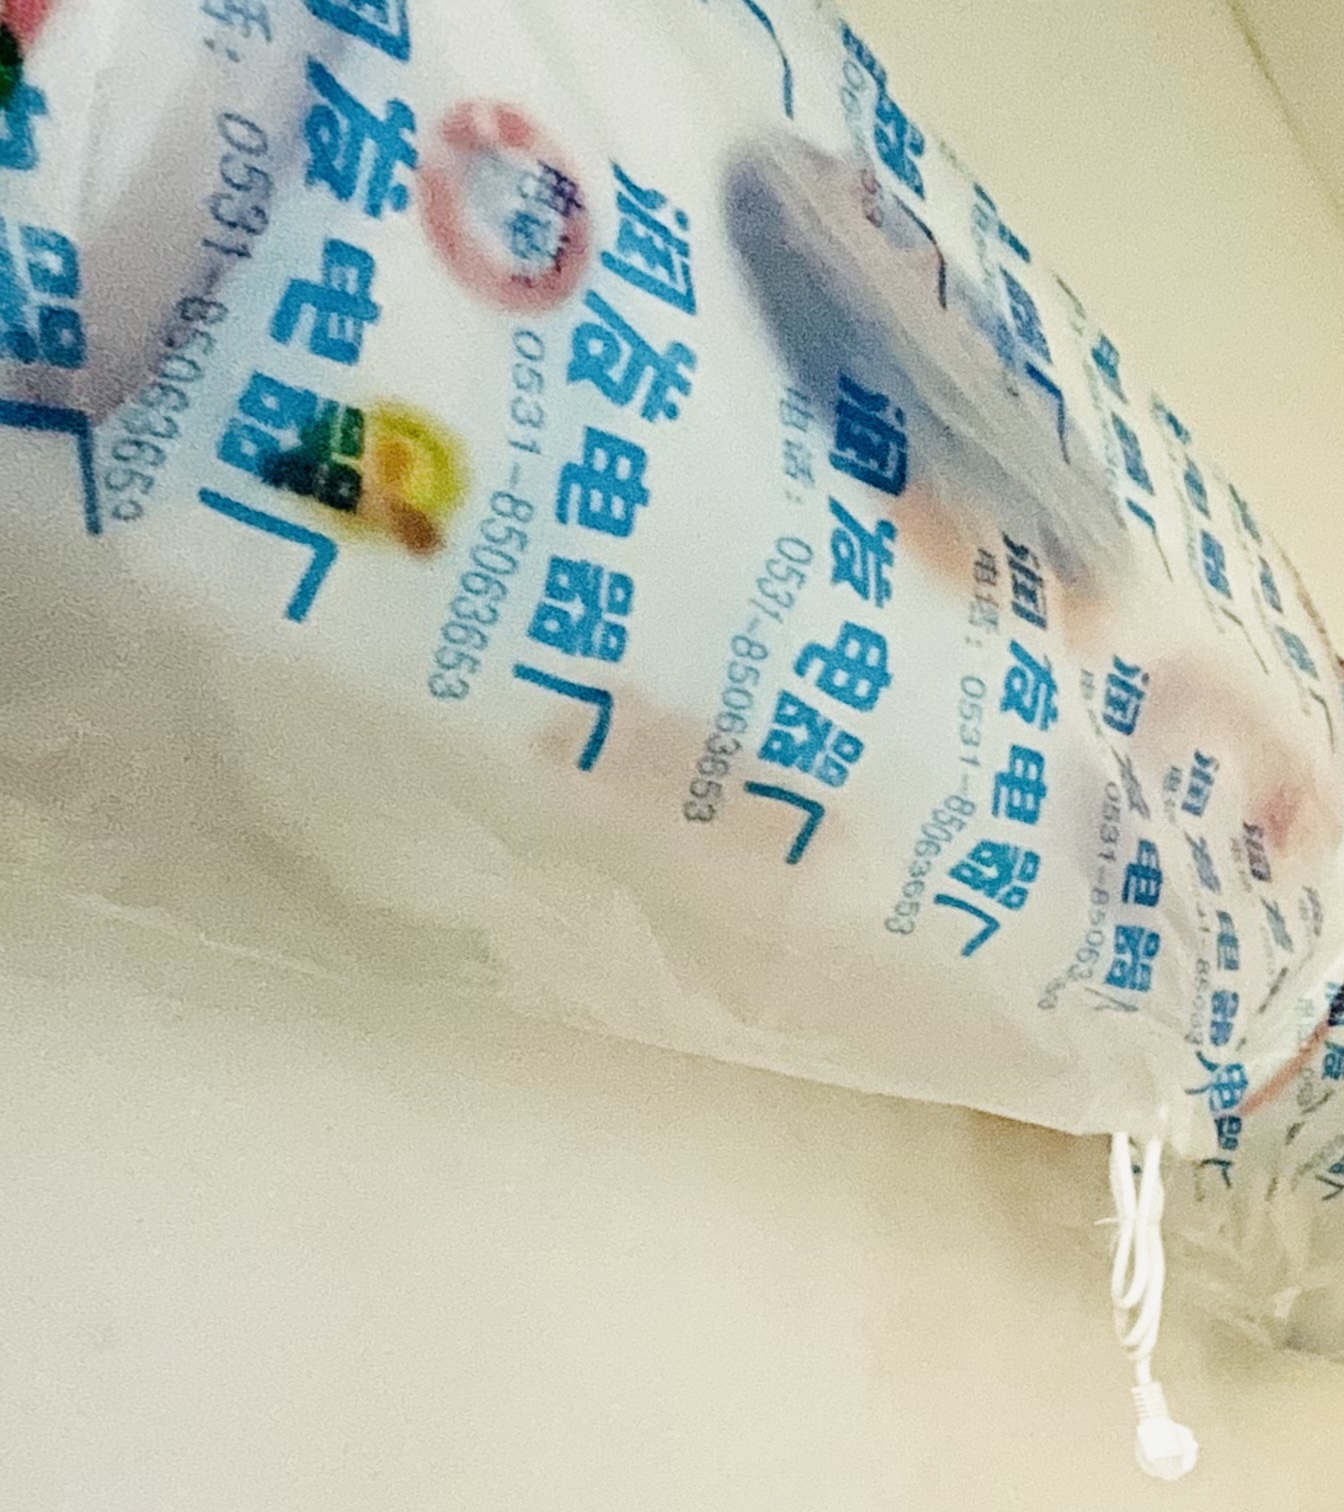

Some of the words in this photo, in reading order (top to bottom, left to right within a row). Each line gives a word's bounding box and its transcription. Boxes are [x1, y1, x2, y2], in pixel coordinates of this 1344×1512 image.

[426, 329, 546, 701] 0531-85063653
[511, 160, 697, 772] 润发电器厂
[742, 372, 908, 864] 润发电器厂
[682, 535, 813, 823] 0531-85063653
[882, 674, 987, 938] 0531-85063653
[931, 530, 1059, 958] 润发电器厂
[1082, 655, 1164, 1013] 润电器厂
